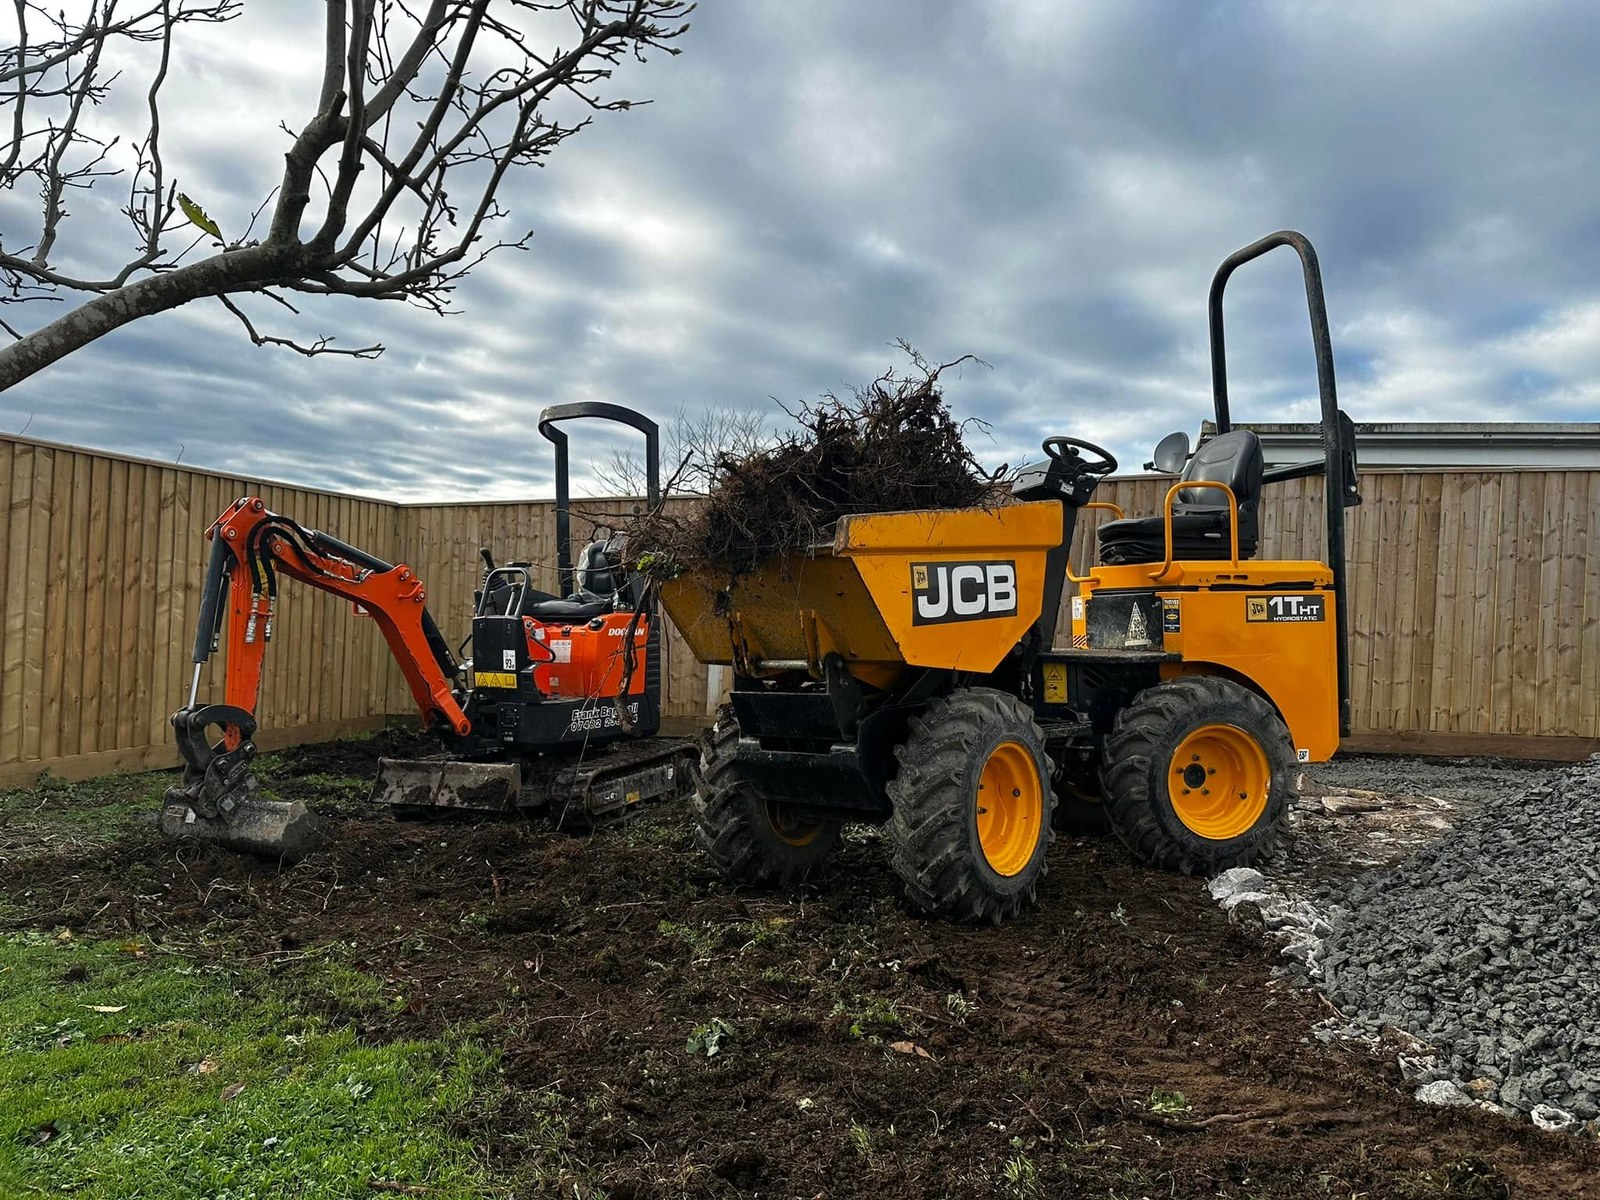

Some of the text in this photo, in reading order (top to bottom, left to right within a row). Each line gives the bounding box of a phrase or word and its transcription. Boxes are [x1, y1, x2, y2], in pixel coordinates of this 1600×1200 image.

[917, 565, 1016, 618] JCB
[608, 628, 645, 636] DOOAN
[571, 707, 600, 721] Frank
